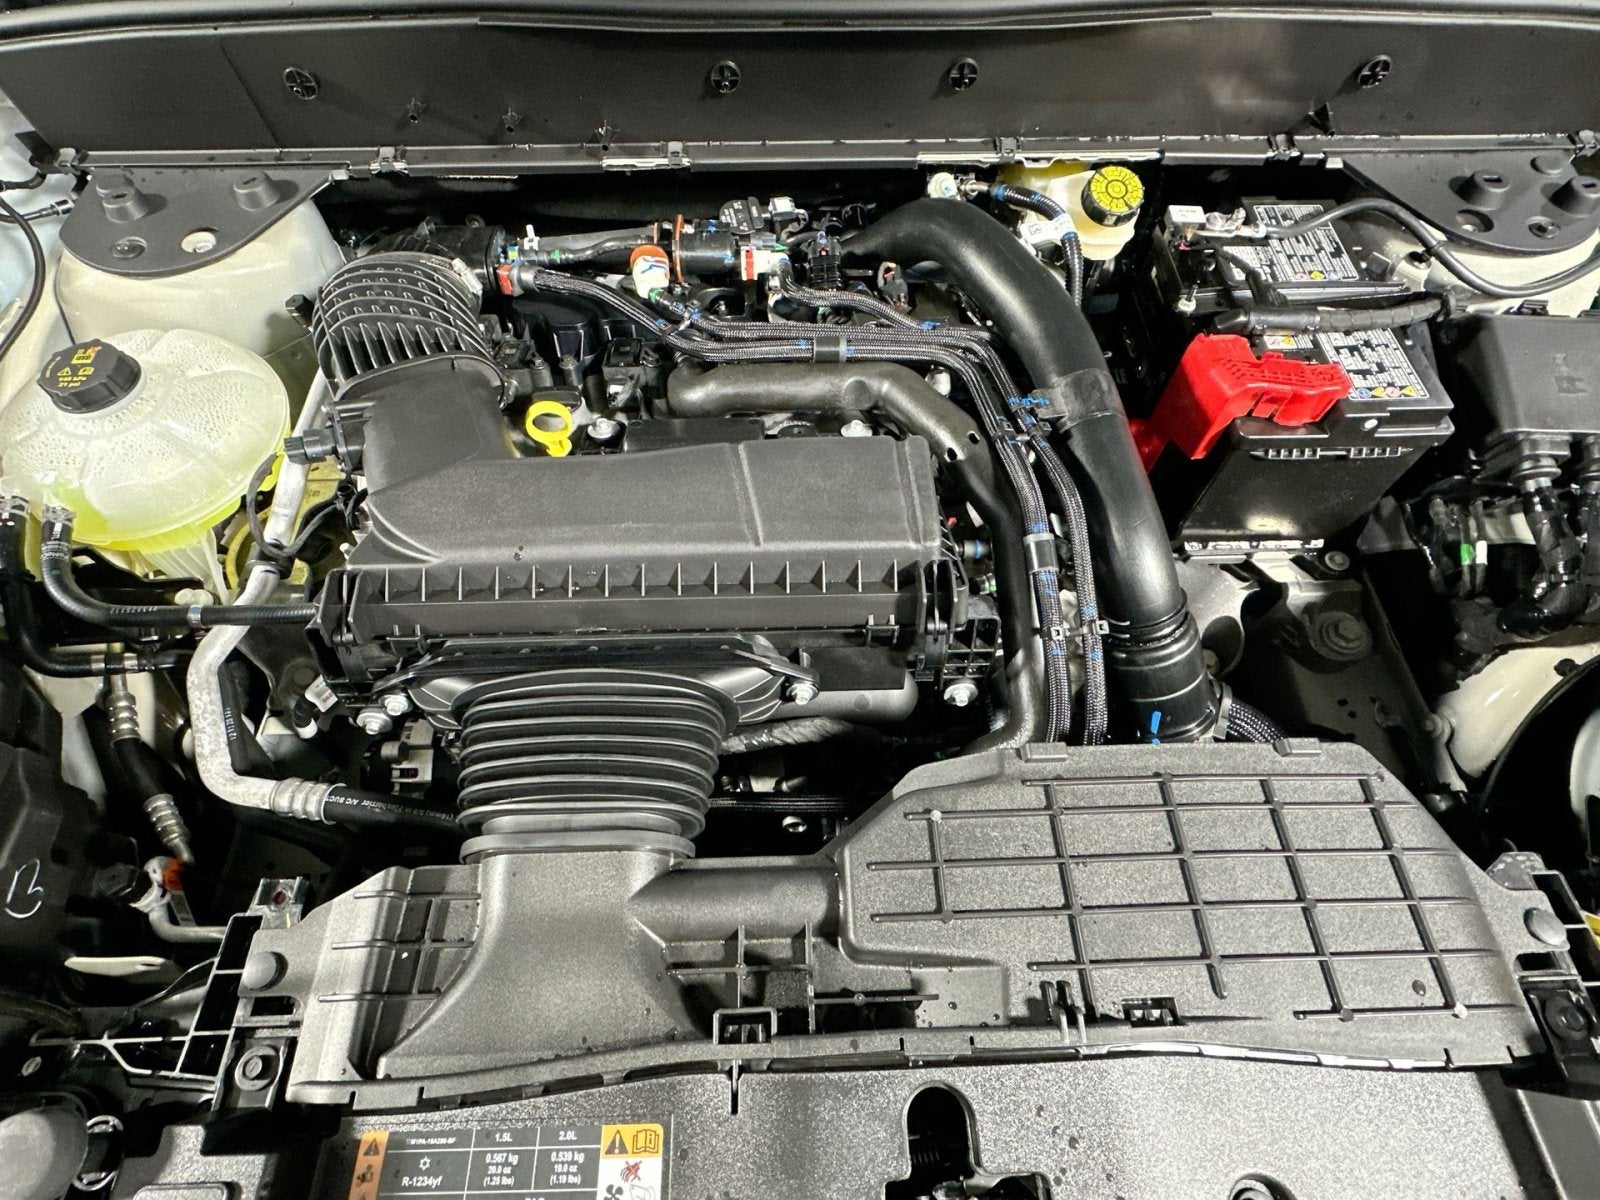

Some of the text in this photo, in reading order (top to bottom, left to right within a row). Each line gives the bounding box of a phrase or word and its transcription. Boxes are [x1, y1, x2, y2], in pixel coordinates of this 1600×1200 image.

[495, 1132, 513, 1142] 1.5L
[558, 1130, 578, 1141] 2.0L
[507, 1153, 519, 1166] kg
[550, 1151, 585, 1164] 0.539 kg
[568, 1165, 578, 1173] oz
[401, 1175, 443, 1189] R-1234yf
[501, 1176, 515, 1187] lbs)
[567, 1174, 582, 1185] lbs)
